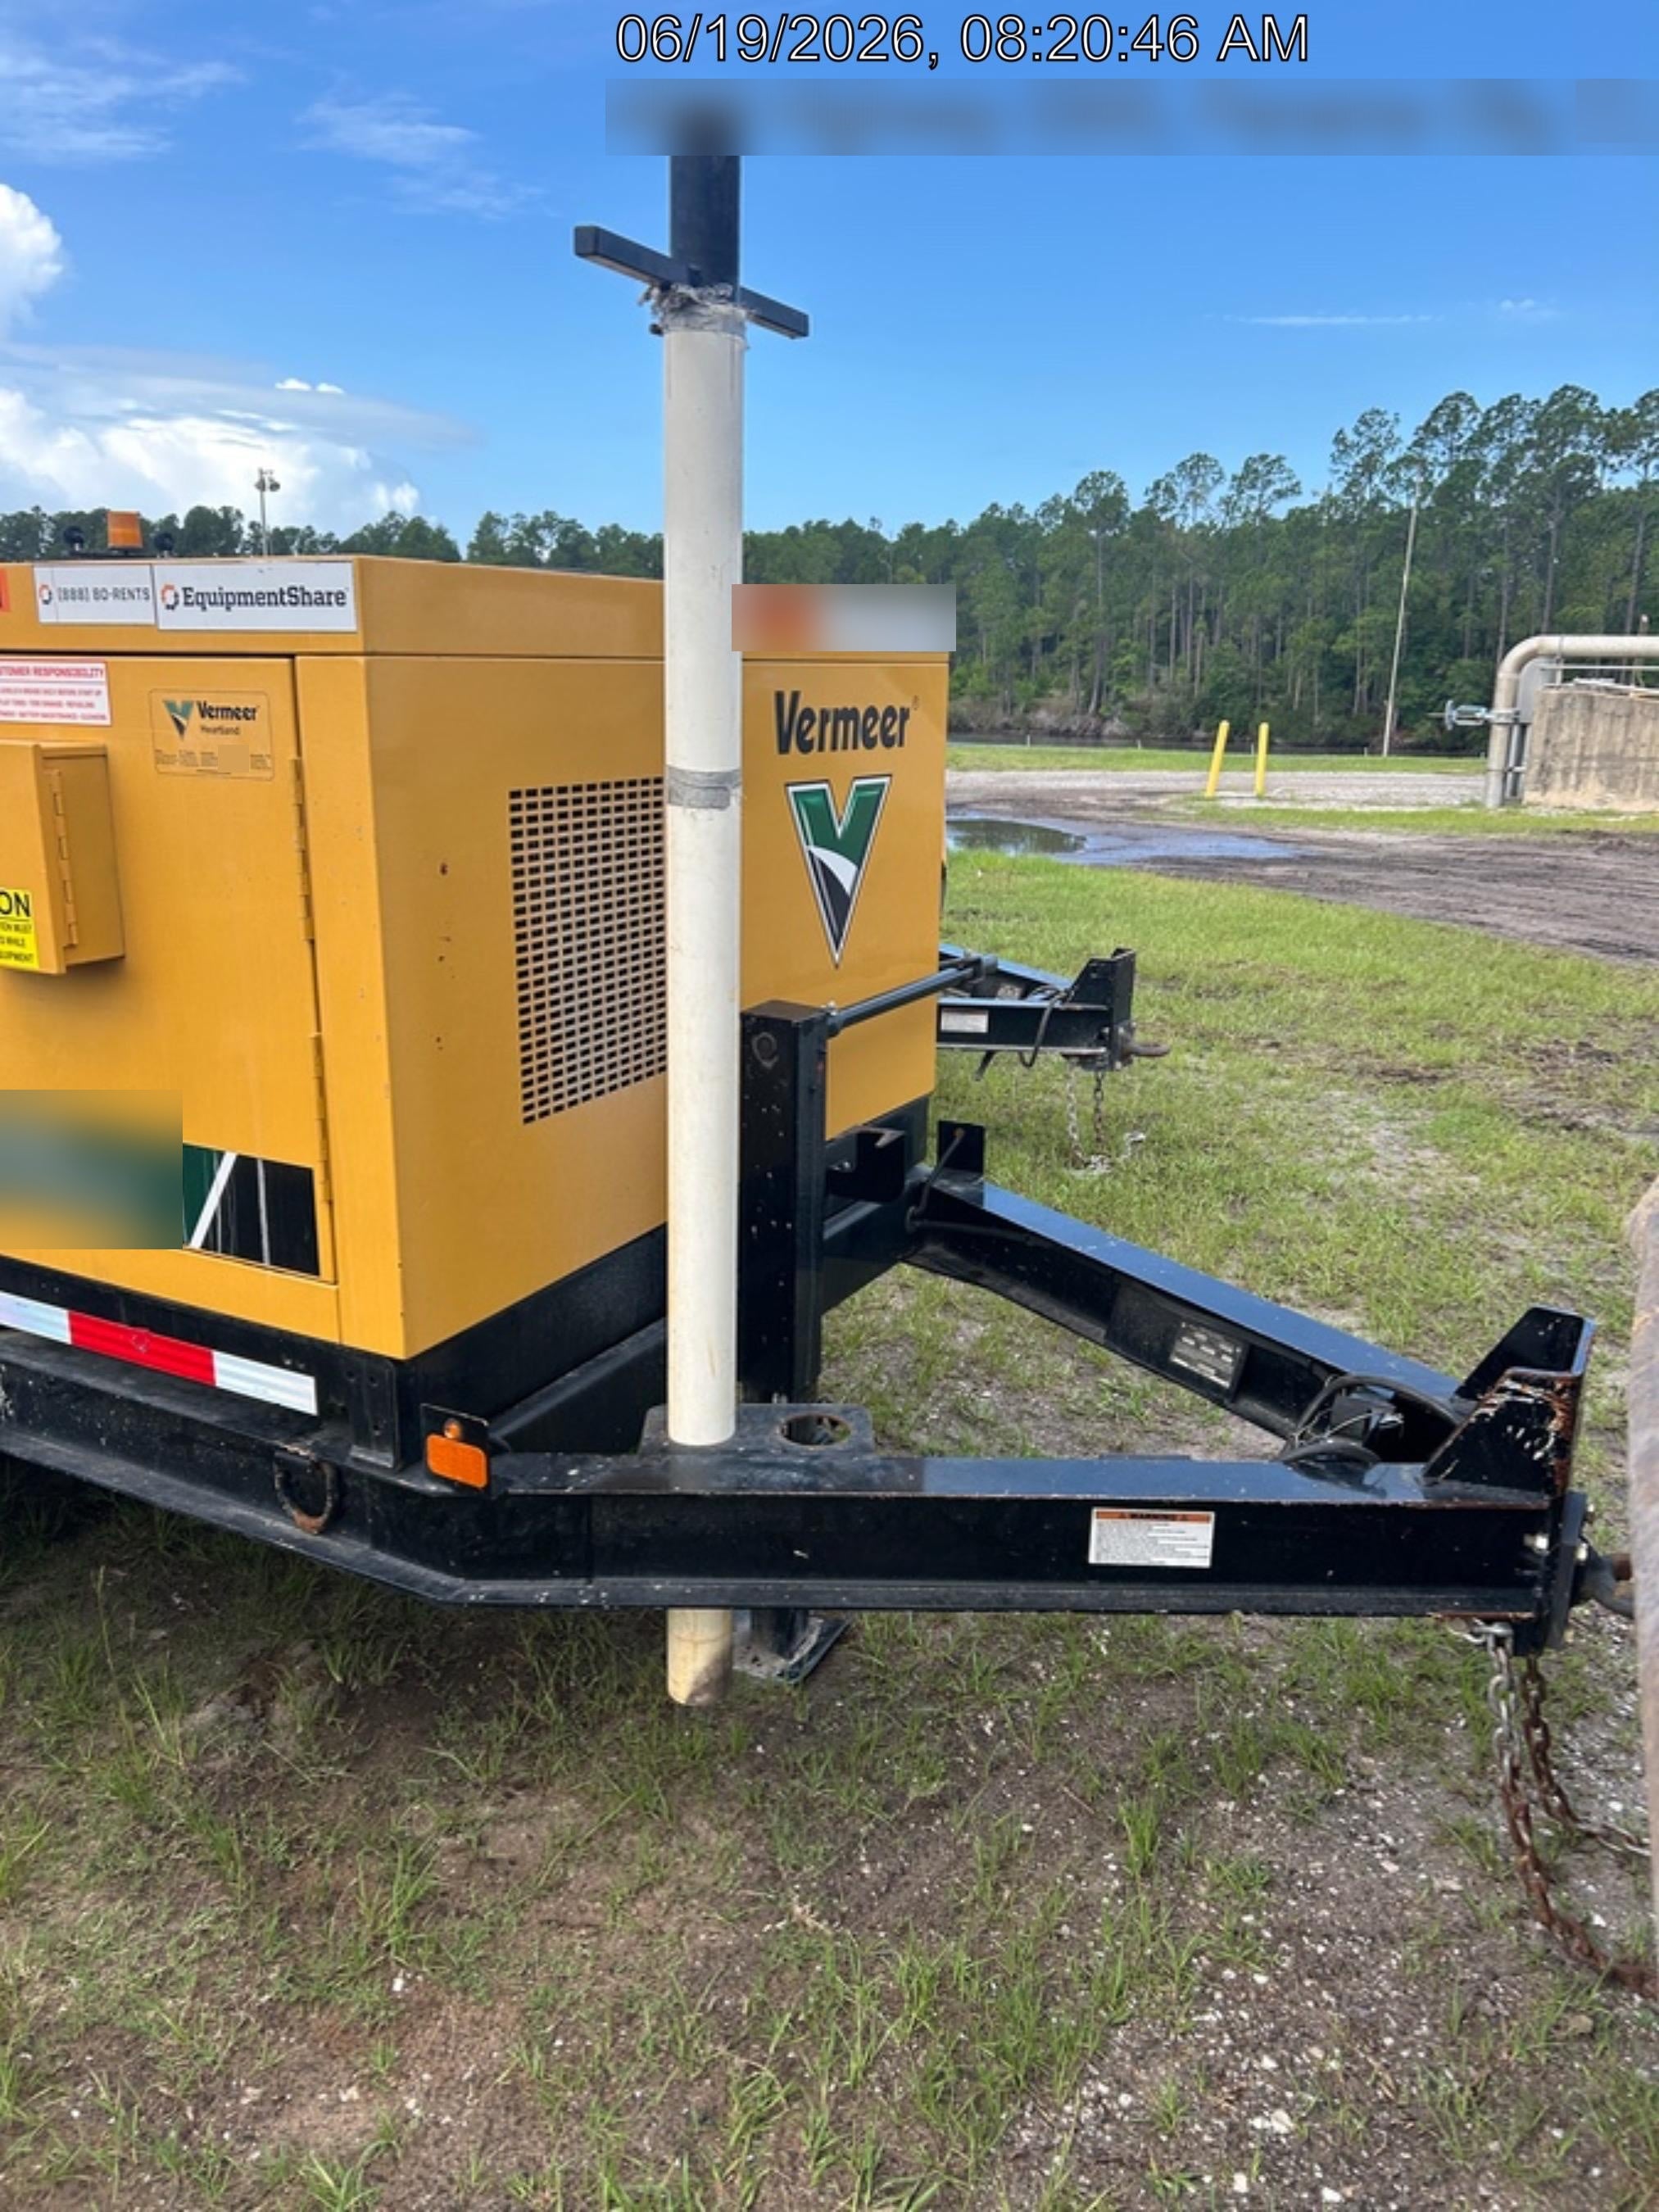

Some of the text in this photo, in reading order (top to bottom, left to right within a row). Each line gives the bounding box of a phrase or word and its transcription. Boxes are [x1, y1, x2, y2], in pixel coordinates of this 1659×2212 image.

[181, 584, 347, 612] EquipmentShare
[197, 700, 257, 721] Vermeer
[774, 690, 910, 755] Vermeer
